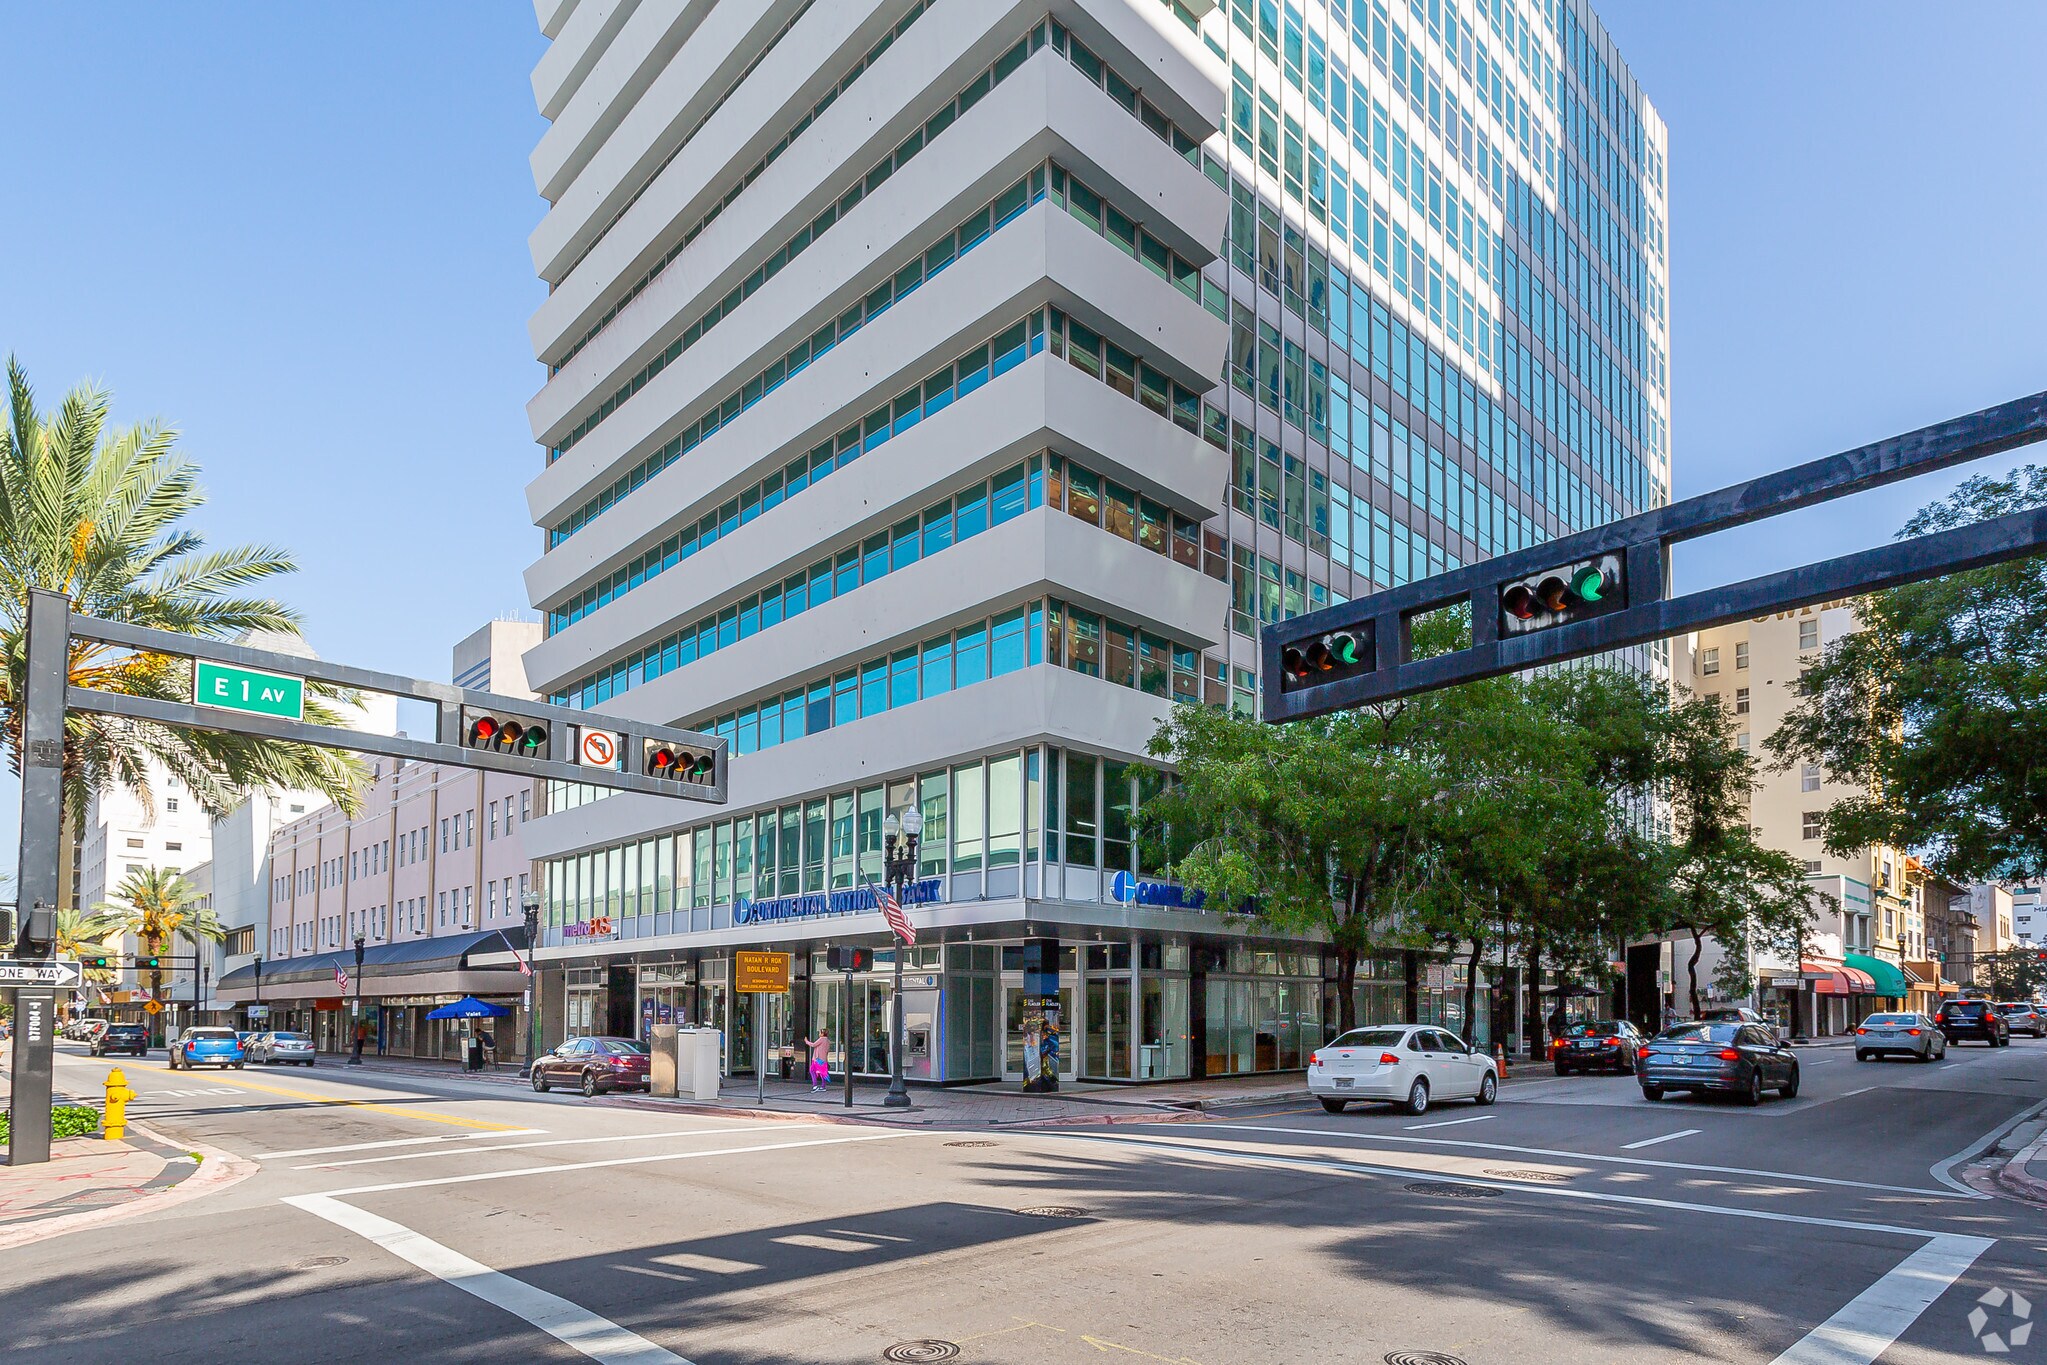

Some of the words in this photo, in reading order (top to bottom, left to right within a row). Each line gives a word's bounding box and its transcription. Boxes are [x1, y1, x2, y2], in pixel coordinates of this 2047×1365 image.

[215, 677, 229, 697] E
[241, 680, 249, 702] 1
[260, 687, 285, 703] AV
[750, 894, 827, 922] CONTINENTAL
[829, 884, 894, 913] NATION
[563, 916, 612, 938] metroPCS
[744, 956, 762, 964] NATAN
[771, 957, 782, 965] ROK
[0, 968, 24, 979] ONE
[36, 968, 63, 979] WAY
[746, 965, 780, 973] BOULEVARD
